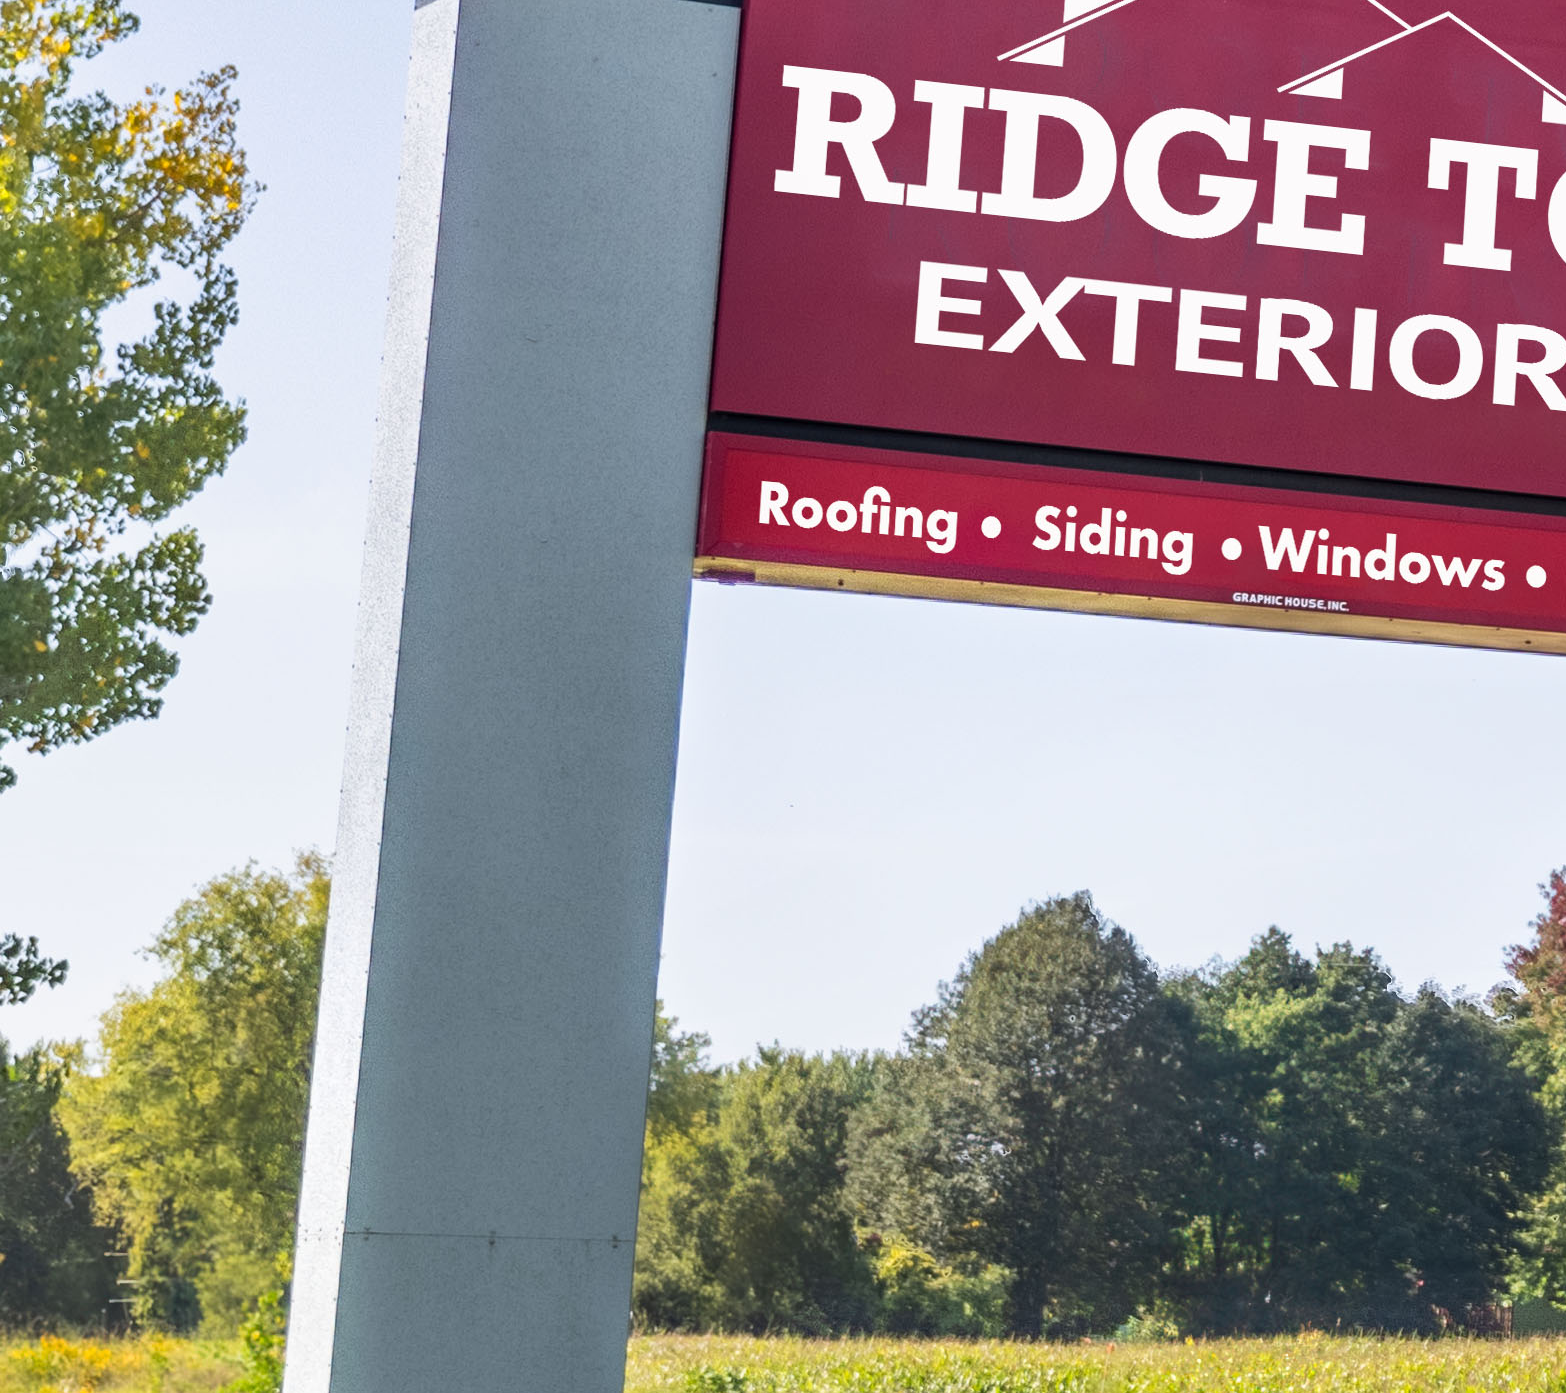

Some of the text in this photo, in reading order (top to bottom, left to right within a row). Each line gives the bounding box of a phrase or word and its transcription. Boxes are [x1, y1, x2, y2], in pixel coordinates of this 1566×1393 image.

[774, 65, 1371, 255] RIDGE
[759, 481, 957, 554] Roofing
[1032, 506, 1193, 575] Siding
[1258, 526, 1505, 591] Windows
[1233, 593, 1282, 605] GRAPHIC
